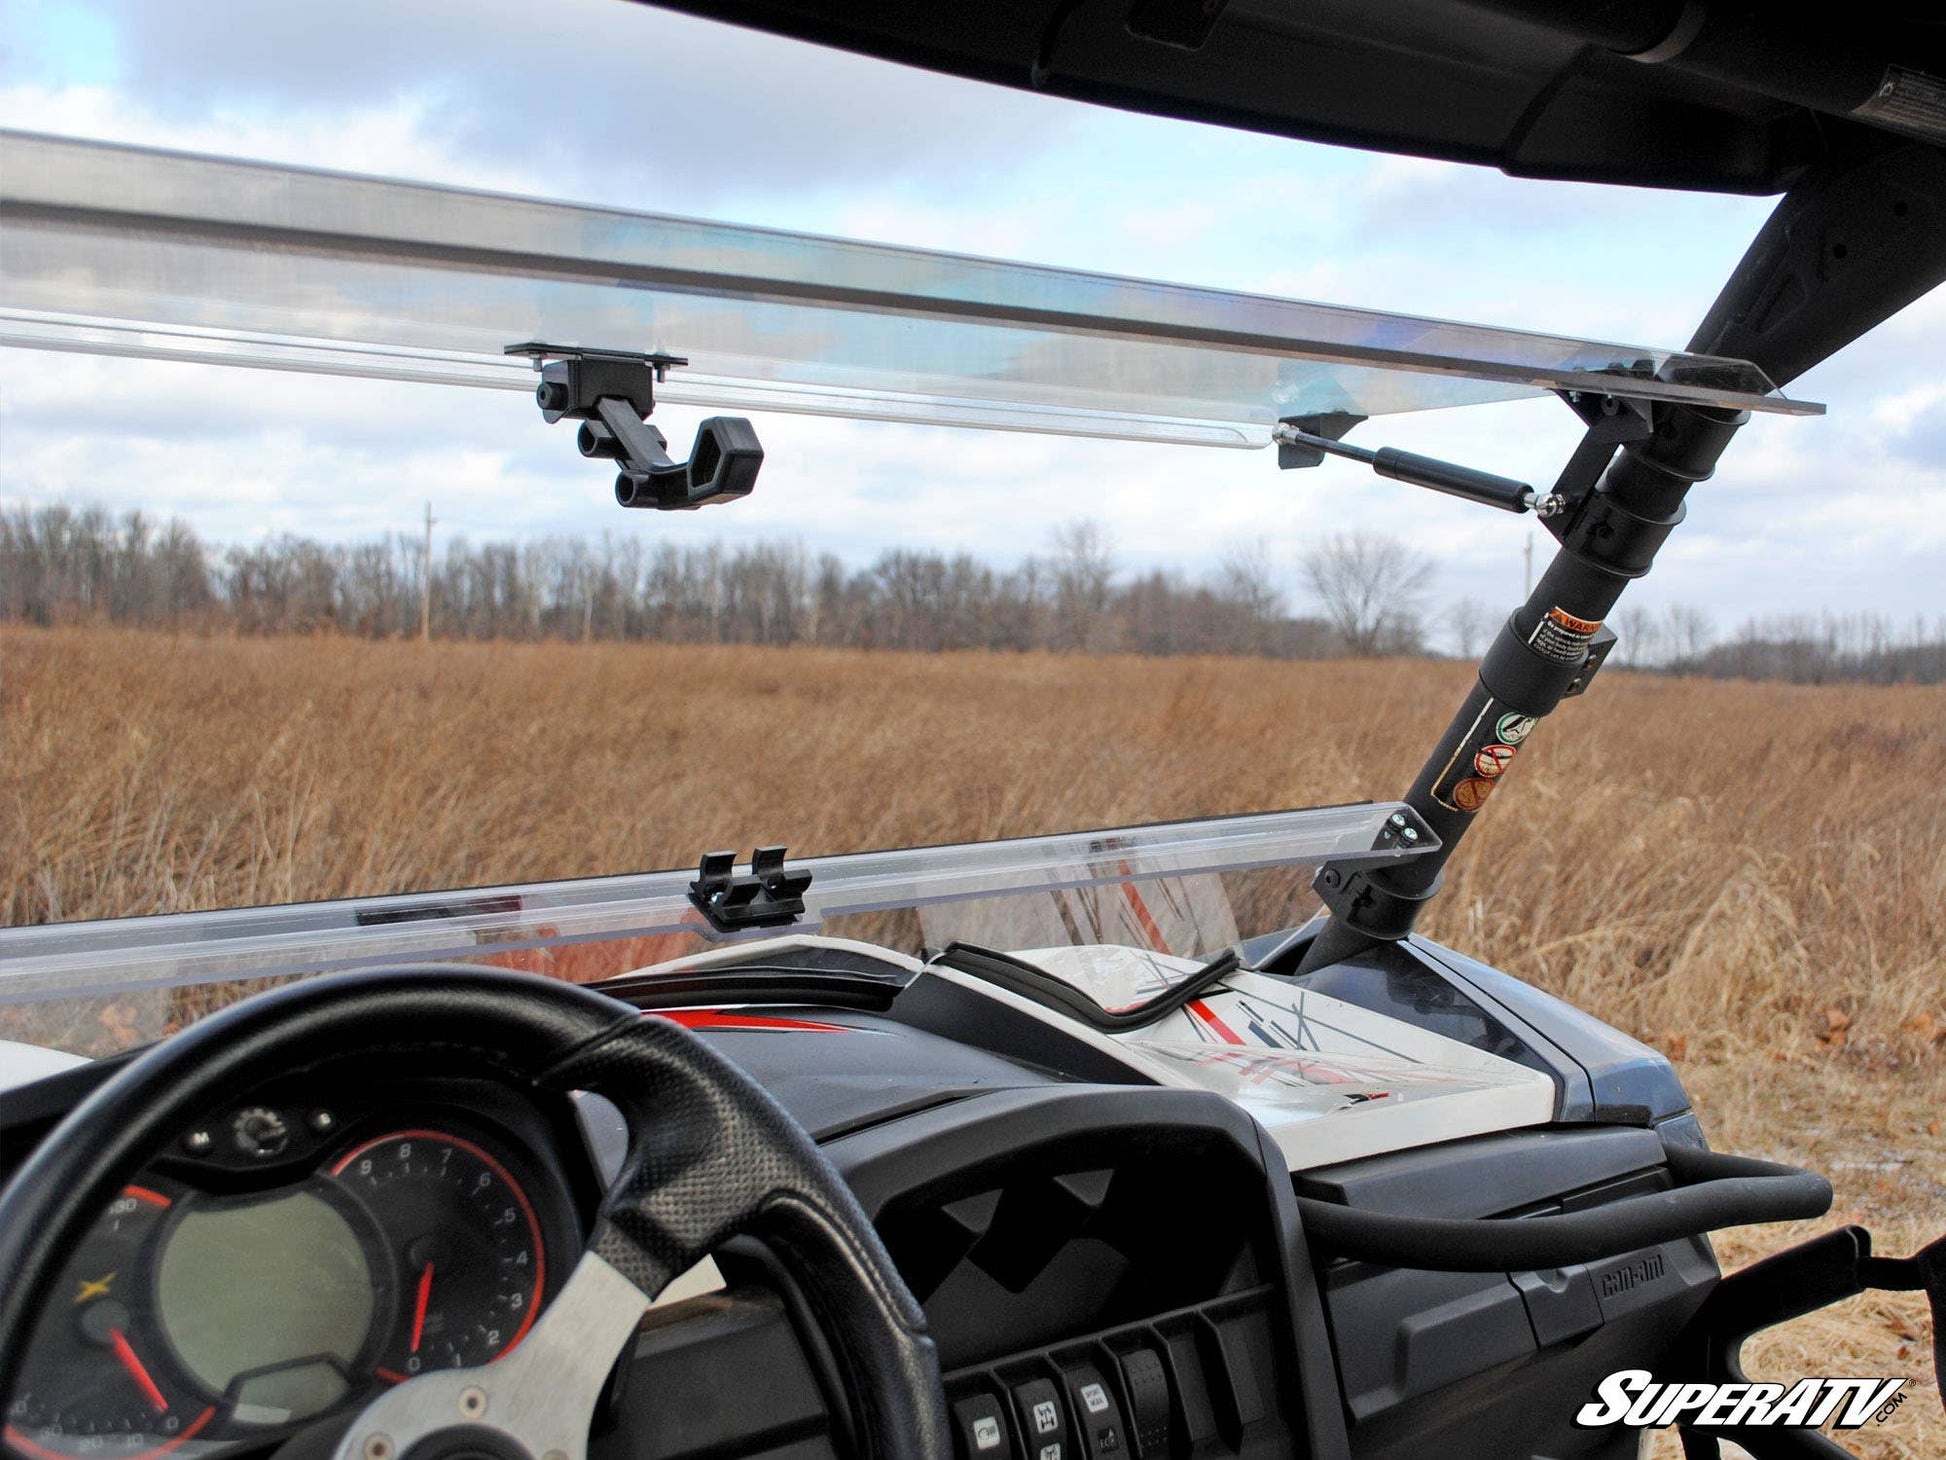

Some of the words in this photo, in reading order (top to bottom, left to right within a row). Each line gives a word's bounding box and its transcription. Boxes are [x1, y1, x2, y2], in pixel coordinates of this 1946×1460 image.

[399, 1142, 412, 1159] 8
[442, 1148, 453, 1164] 7
[359, 1159, 372, 1175] 9
[480, 1172, 492, 1187] 6
[504, 1207, 516, 1223] 5
[516, 1250, 528, 1265] 4
[511, 1293, 523, 1309] 3
[487, 1330, 500, 1345] 2
[408, 1356, 420, 1372] 0
[166, 1416, 178, 1431] 0
